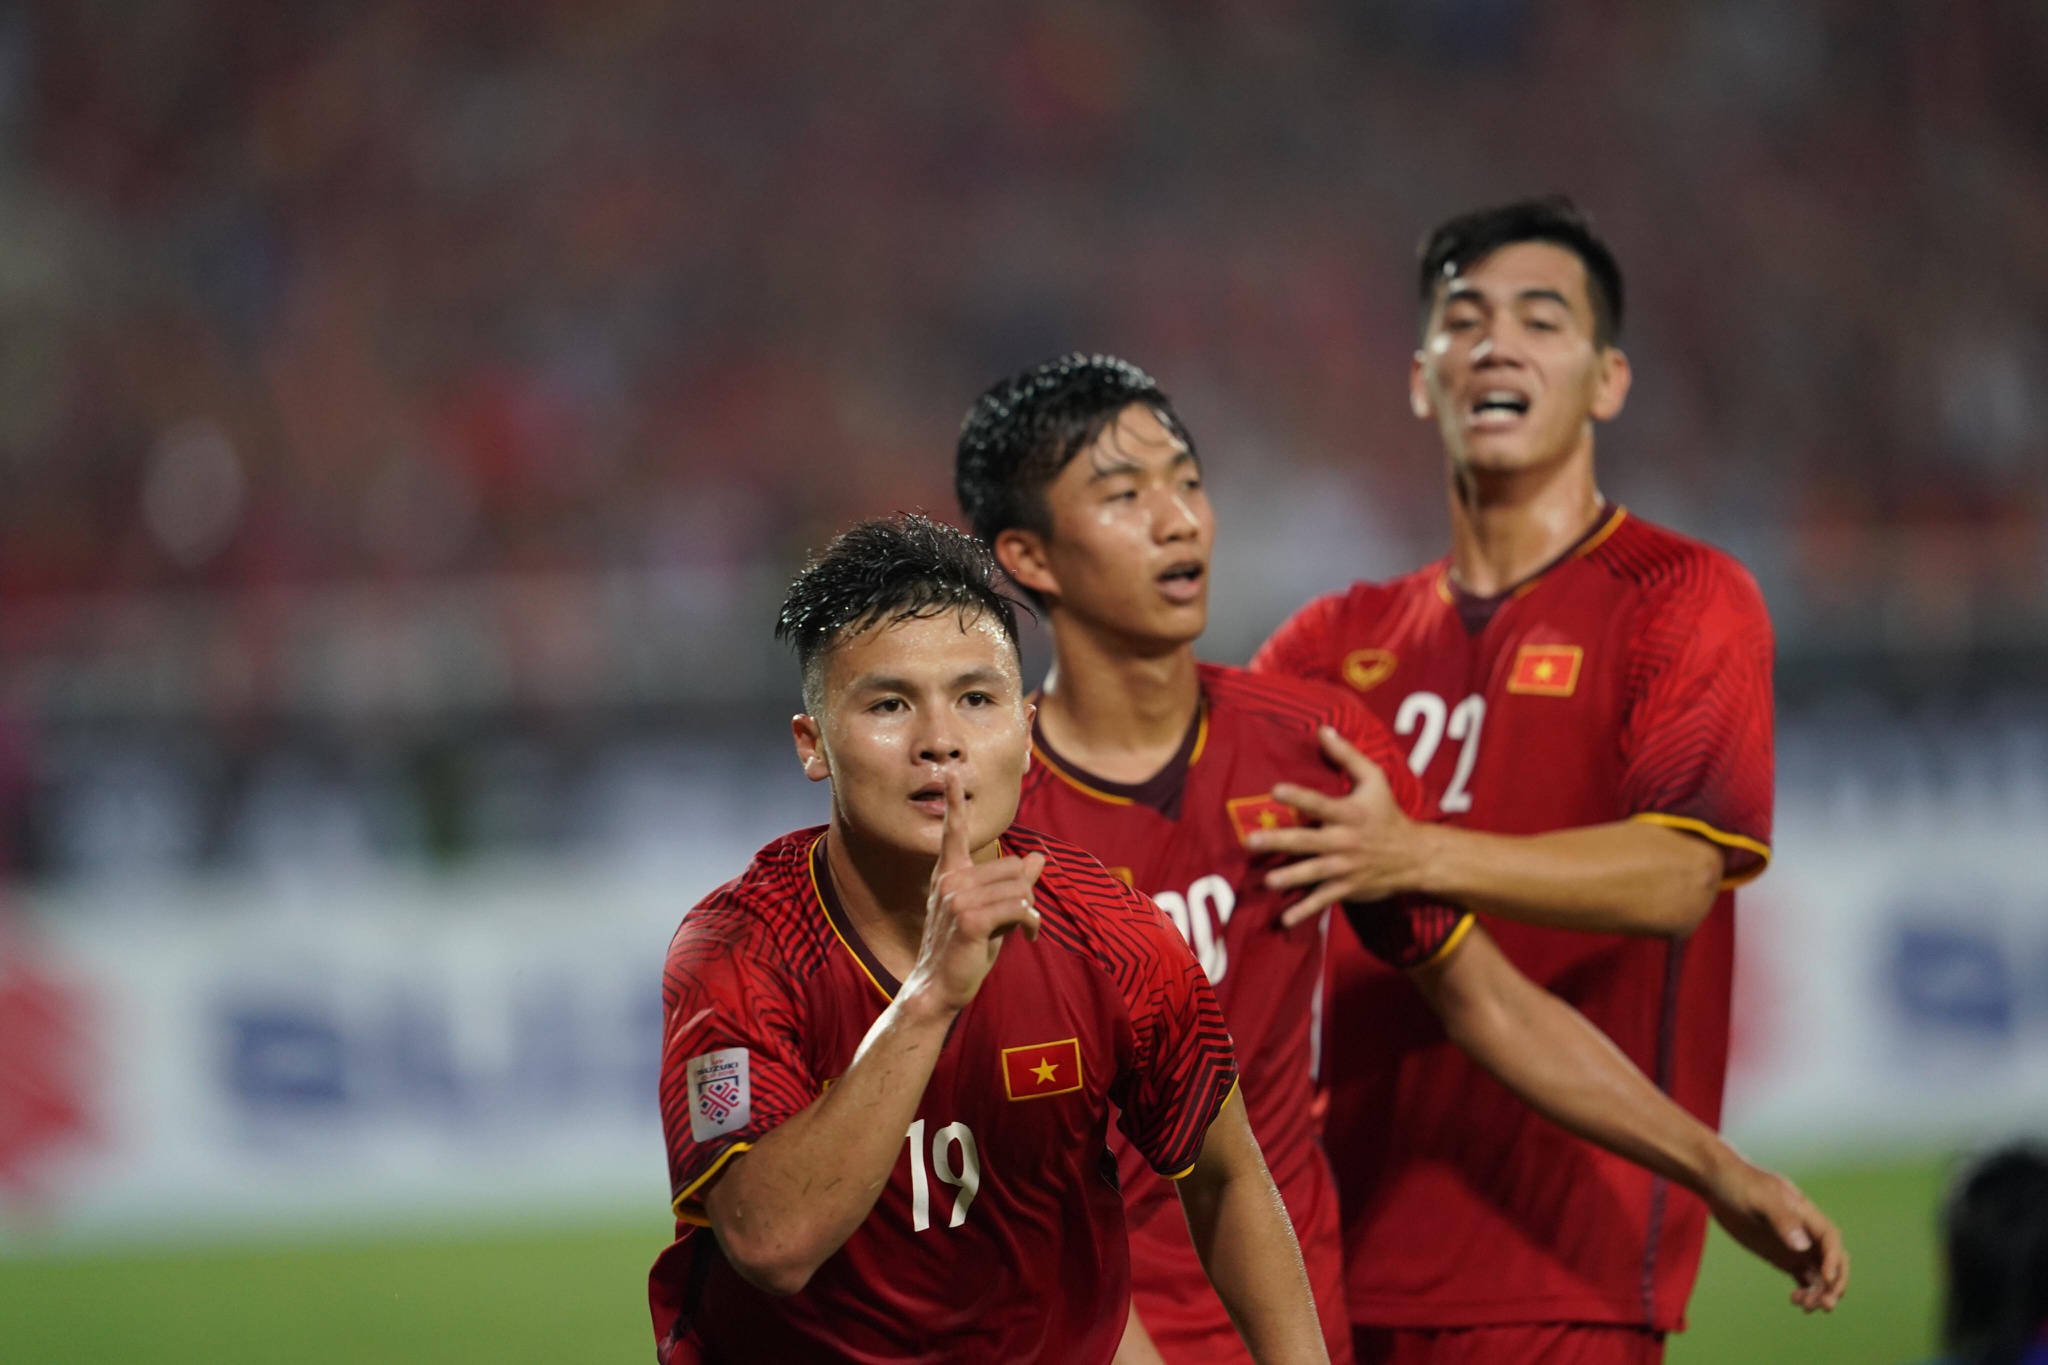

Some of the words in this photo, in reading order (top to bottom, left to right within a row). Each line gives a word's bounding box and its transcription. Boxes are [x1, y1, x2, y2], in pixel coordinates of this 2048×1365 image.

[1394, 691, 1486, 812] 22
[697, 1062, 738, 1075] SUZUKI
[905, 1119, 980, 1232] 19
